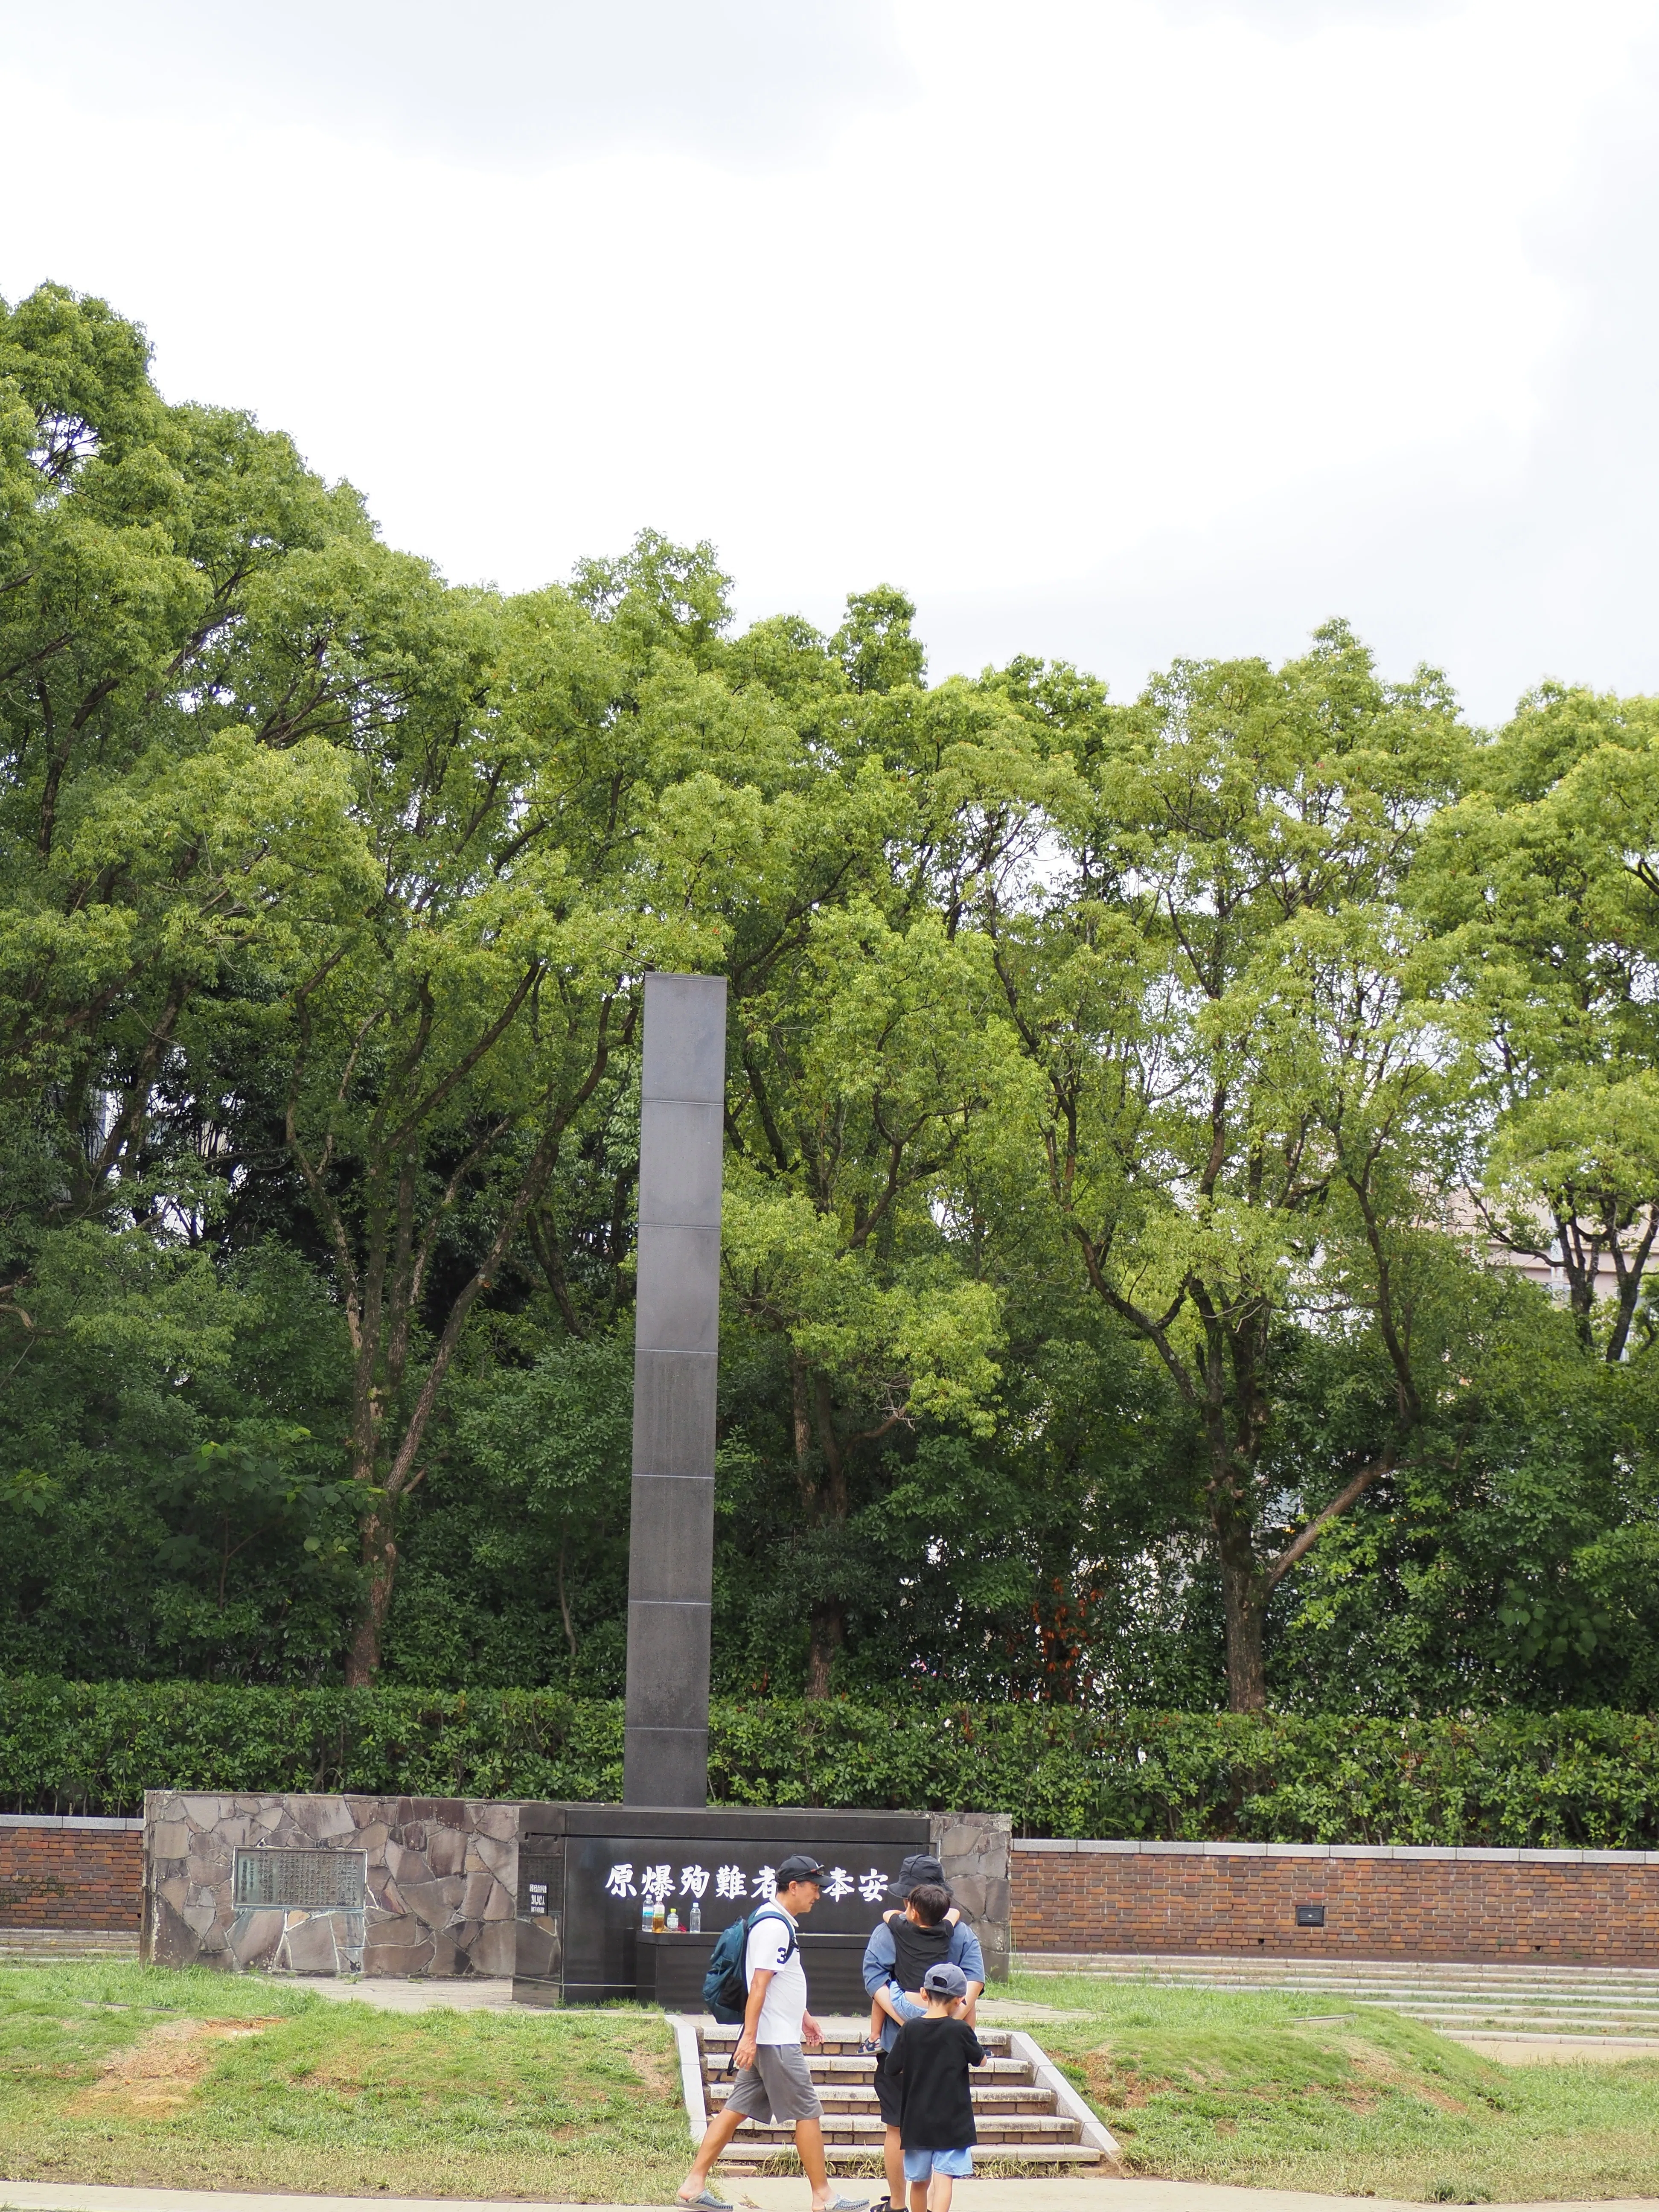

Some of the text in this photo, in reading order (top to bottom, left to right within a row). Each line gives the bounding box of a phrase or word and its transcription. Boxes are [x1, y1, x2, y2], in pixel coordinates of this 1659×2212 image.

[605, 1863, 888, 1902] 原爆殉難者奉安
